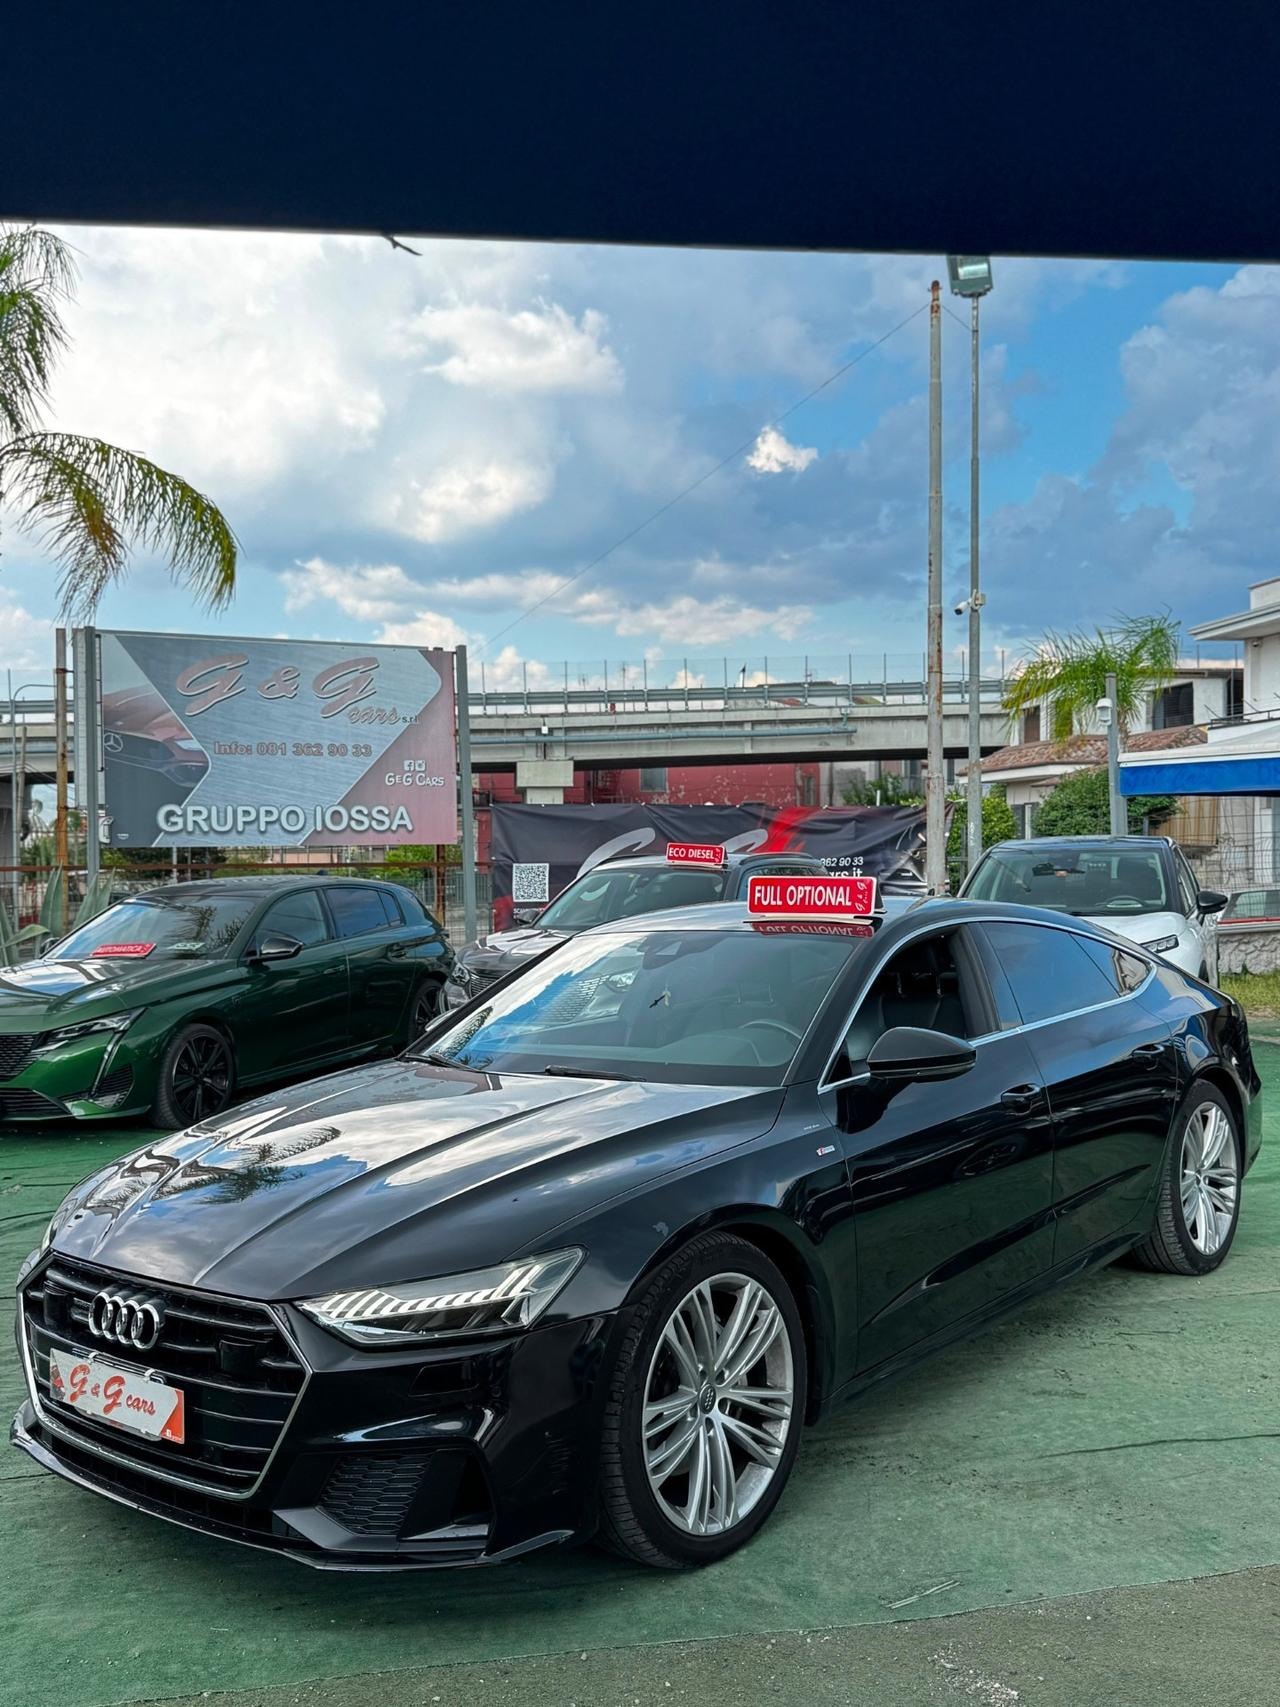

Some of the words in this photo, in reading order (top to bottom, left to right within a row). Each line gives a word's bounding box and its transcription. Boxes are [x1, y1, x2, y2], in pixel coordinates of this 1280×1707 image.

[176, 653, 249, 717] G
[257, 666, 300, 699] &
[312, 656, 380, 719] G
[213, 741, 252, 756] Info:
[257, 742, 287, 756] 081
[292, 743, 323, 757] 362
[328, 743, 348, 757] 90
[352, 744, 373, 757] 33
[156, 804, 305, 834] GRUPPO
[314, 804, 414, 834] IOSSA
[669, 847, 686, 858] ECO
[688, 848, 714, 860] DIESEL
[839, 857, 851, 867] 90
[852, 856, 864, 866] 33
[754, 885, 783, 906] FULL
[786, 885, 853, 907] OPTIONAL
[69, 1364, 91, 1403] G
[91, 1383, 100, 1397] &
[103, 1375, 125, 1415] G
[125, 1393, 156, 1416] cars
